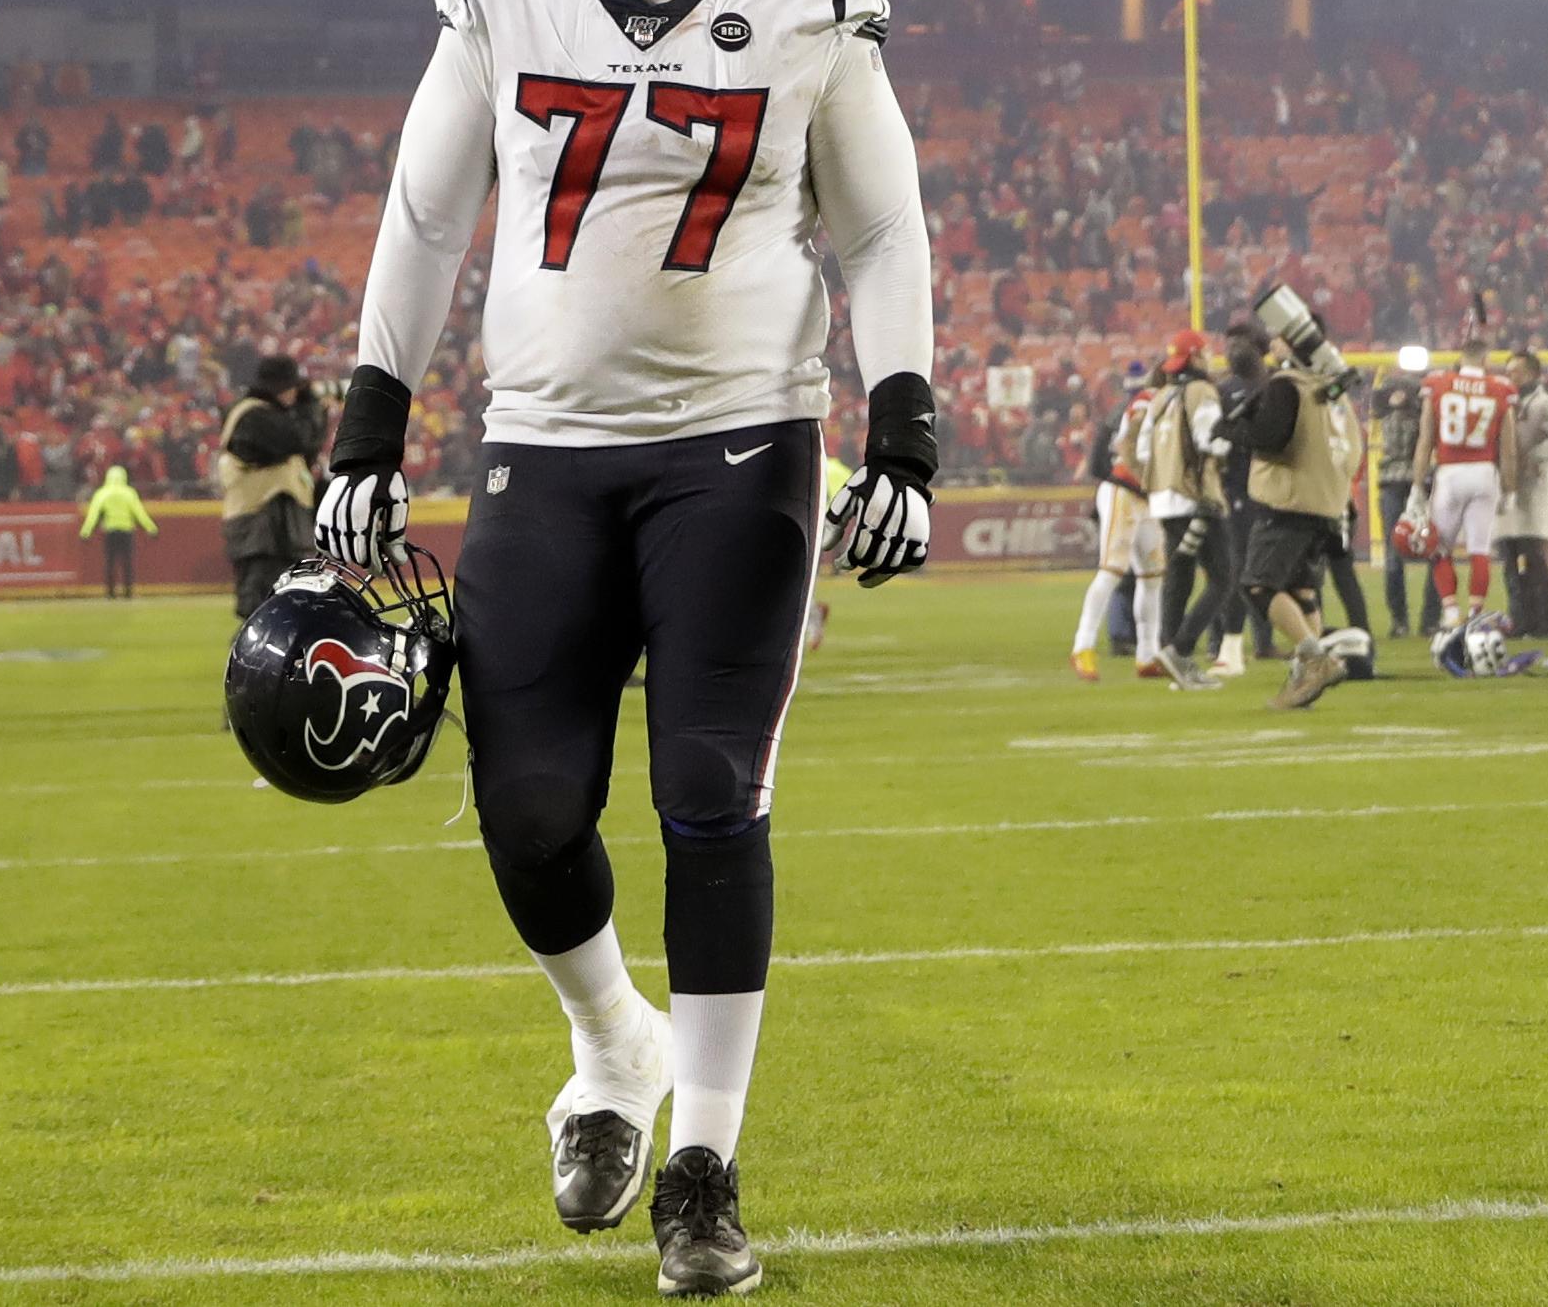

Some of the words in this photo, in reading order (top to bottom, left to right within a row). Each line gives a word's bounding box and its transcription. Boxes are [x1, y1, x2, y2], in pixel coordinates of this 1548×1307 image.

[607, 62, 684, 73] TEXANS
[514, 71, 772, 273] 77
[1439, 393, 1498, 448] 87
